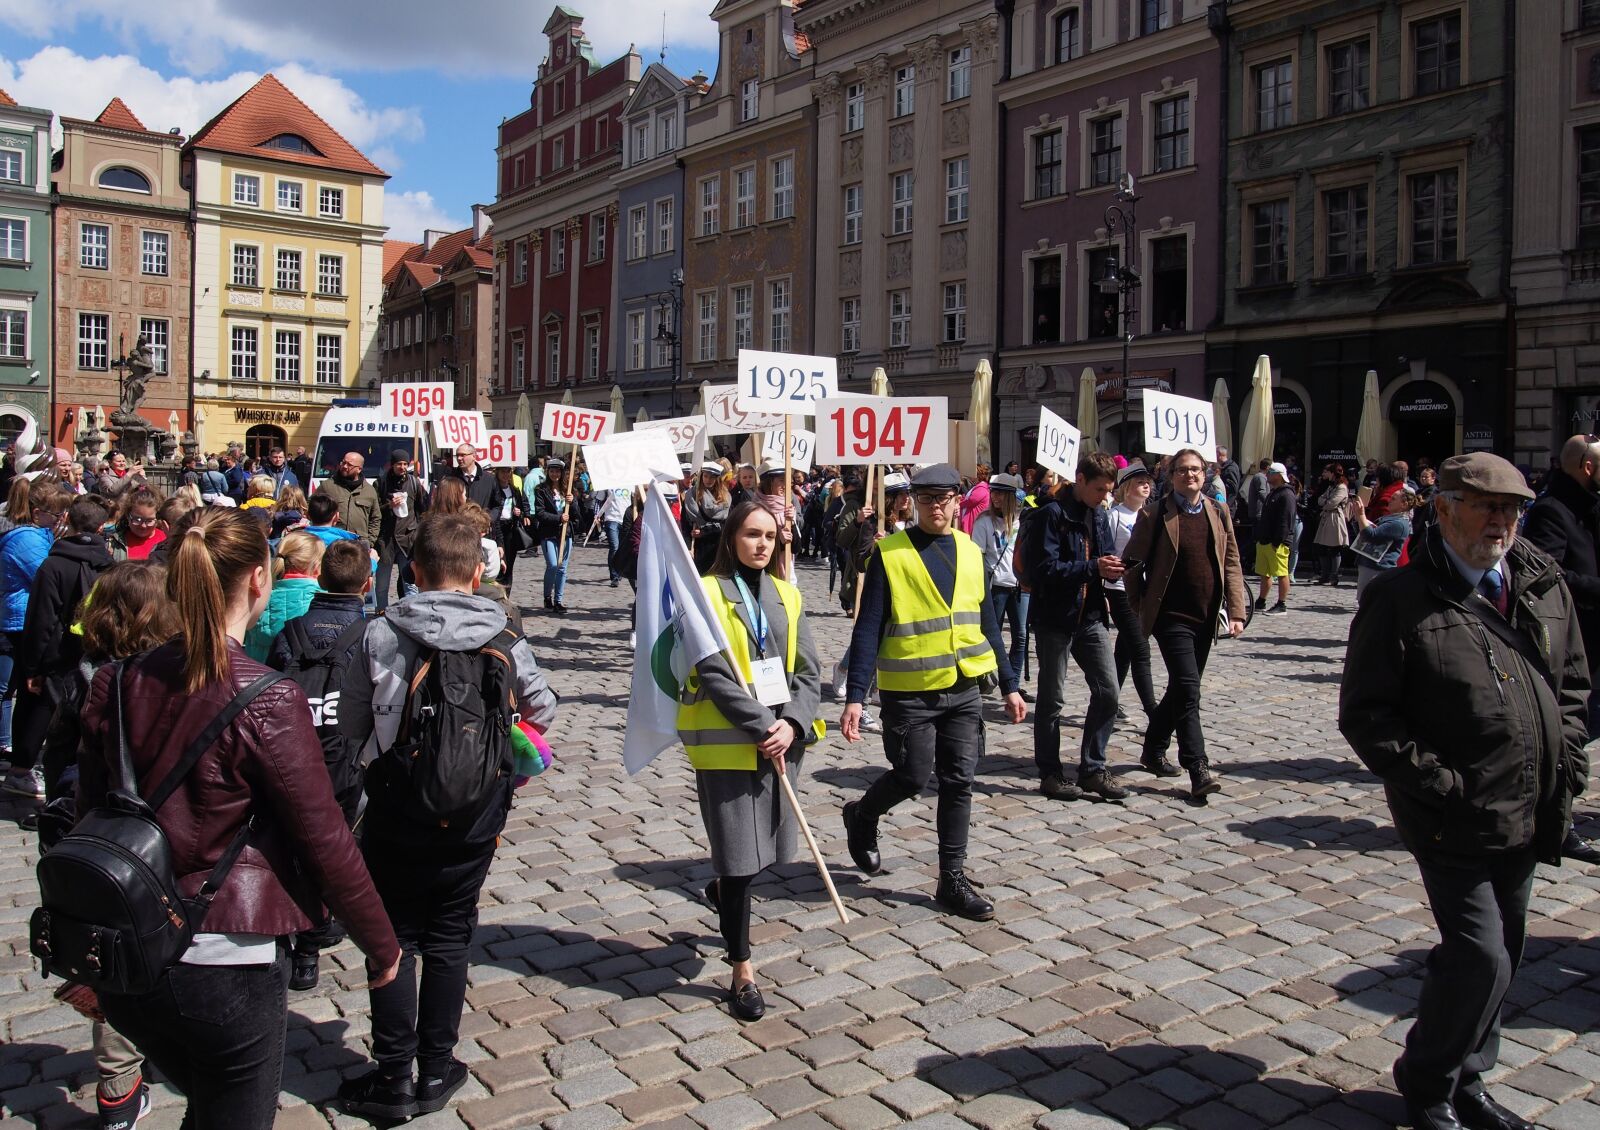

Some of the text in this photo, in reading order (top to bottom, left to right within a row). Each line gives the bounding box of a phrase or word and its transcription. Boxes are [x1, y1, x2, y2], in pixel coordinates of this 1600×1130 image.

[748, 364, 827, 401] 1925
[236, 407, 276, 421] WHISKEY
[284, 409, 300, 422] JAR
[389, 387, 445, 417] 1959
[334, 422, 409, 434] SOBOMED
[439, 414, 479, 444] 1967
[551, 409, 606, 442] 1957
[668, 424, 695, 447] 39
[830, 406, 931, 457] 1947
[1152, 405, 1208, 447] 1919
[1041, 423, 1075, 467] 1927
